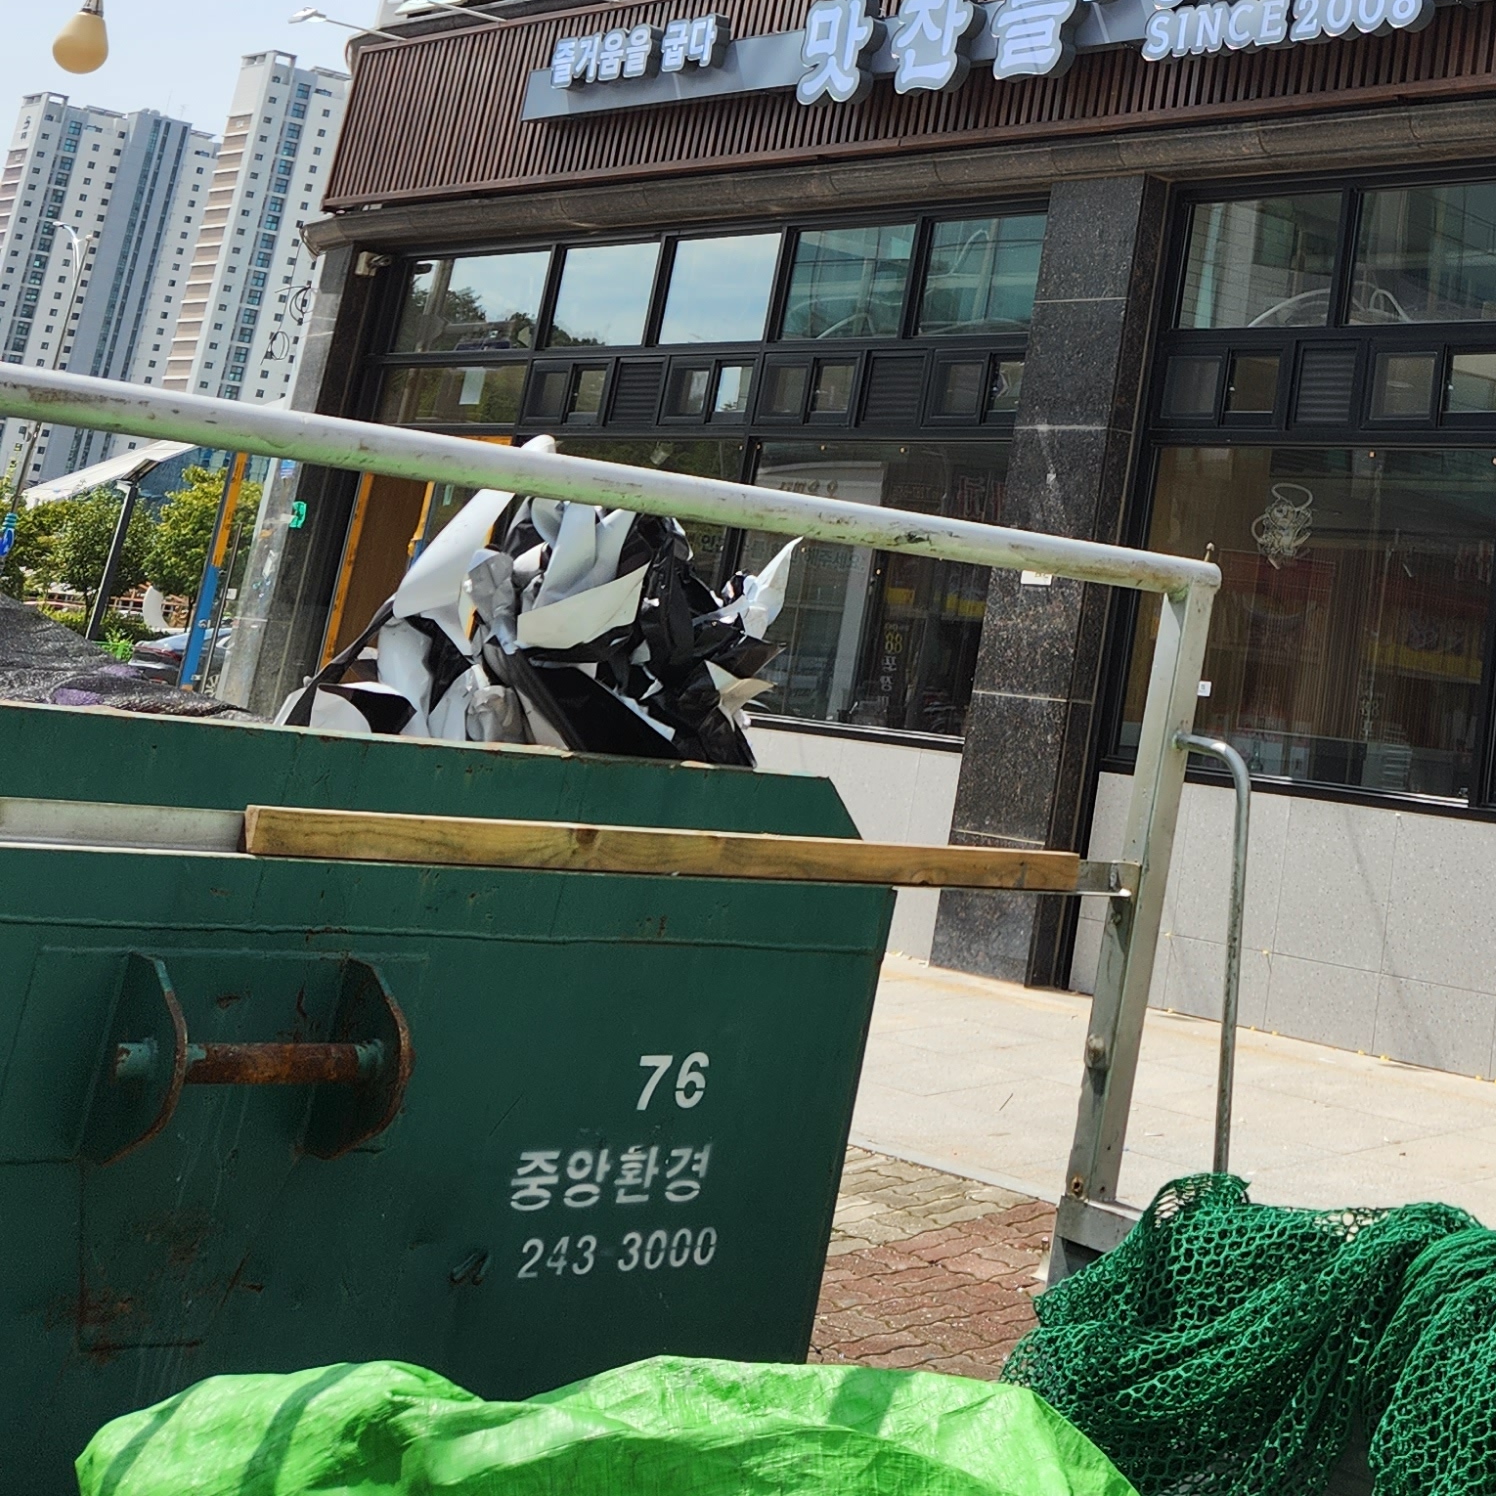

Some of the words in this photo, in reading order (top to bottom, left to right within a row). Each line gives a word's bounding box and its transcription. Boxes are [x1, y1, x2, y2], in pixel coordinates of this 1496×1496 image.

[552, 25, 660, 89] 즐거움을
[661, 14, 727, 73] 굽다
[636, 1051, 710, 1111] 76
[510, 1143, 713, 1212] 중앙환경
[517, 1235, 597, 1279] 243
[617, 1226, 718, 1272] 3000
